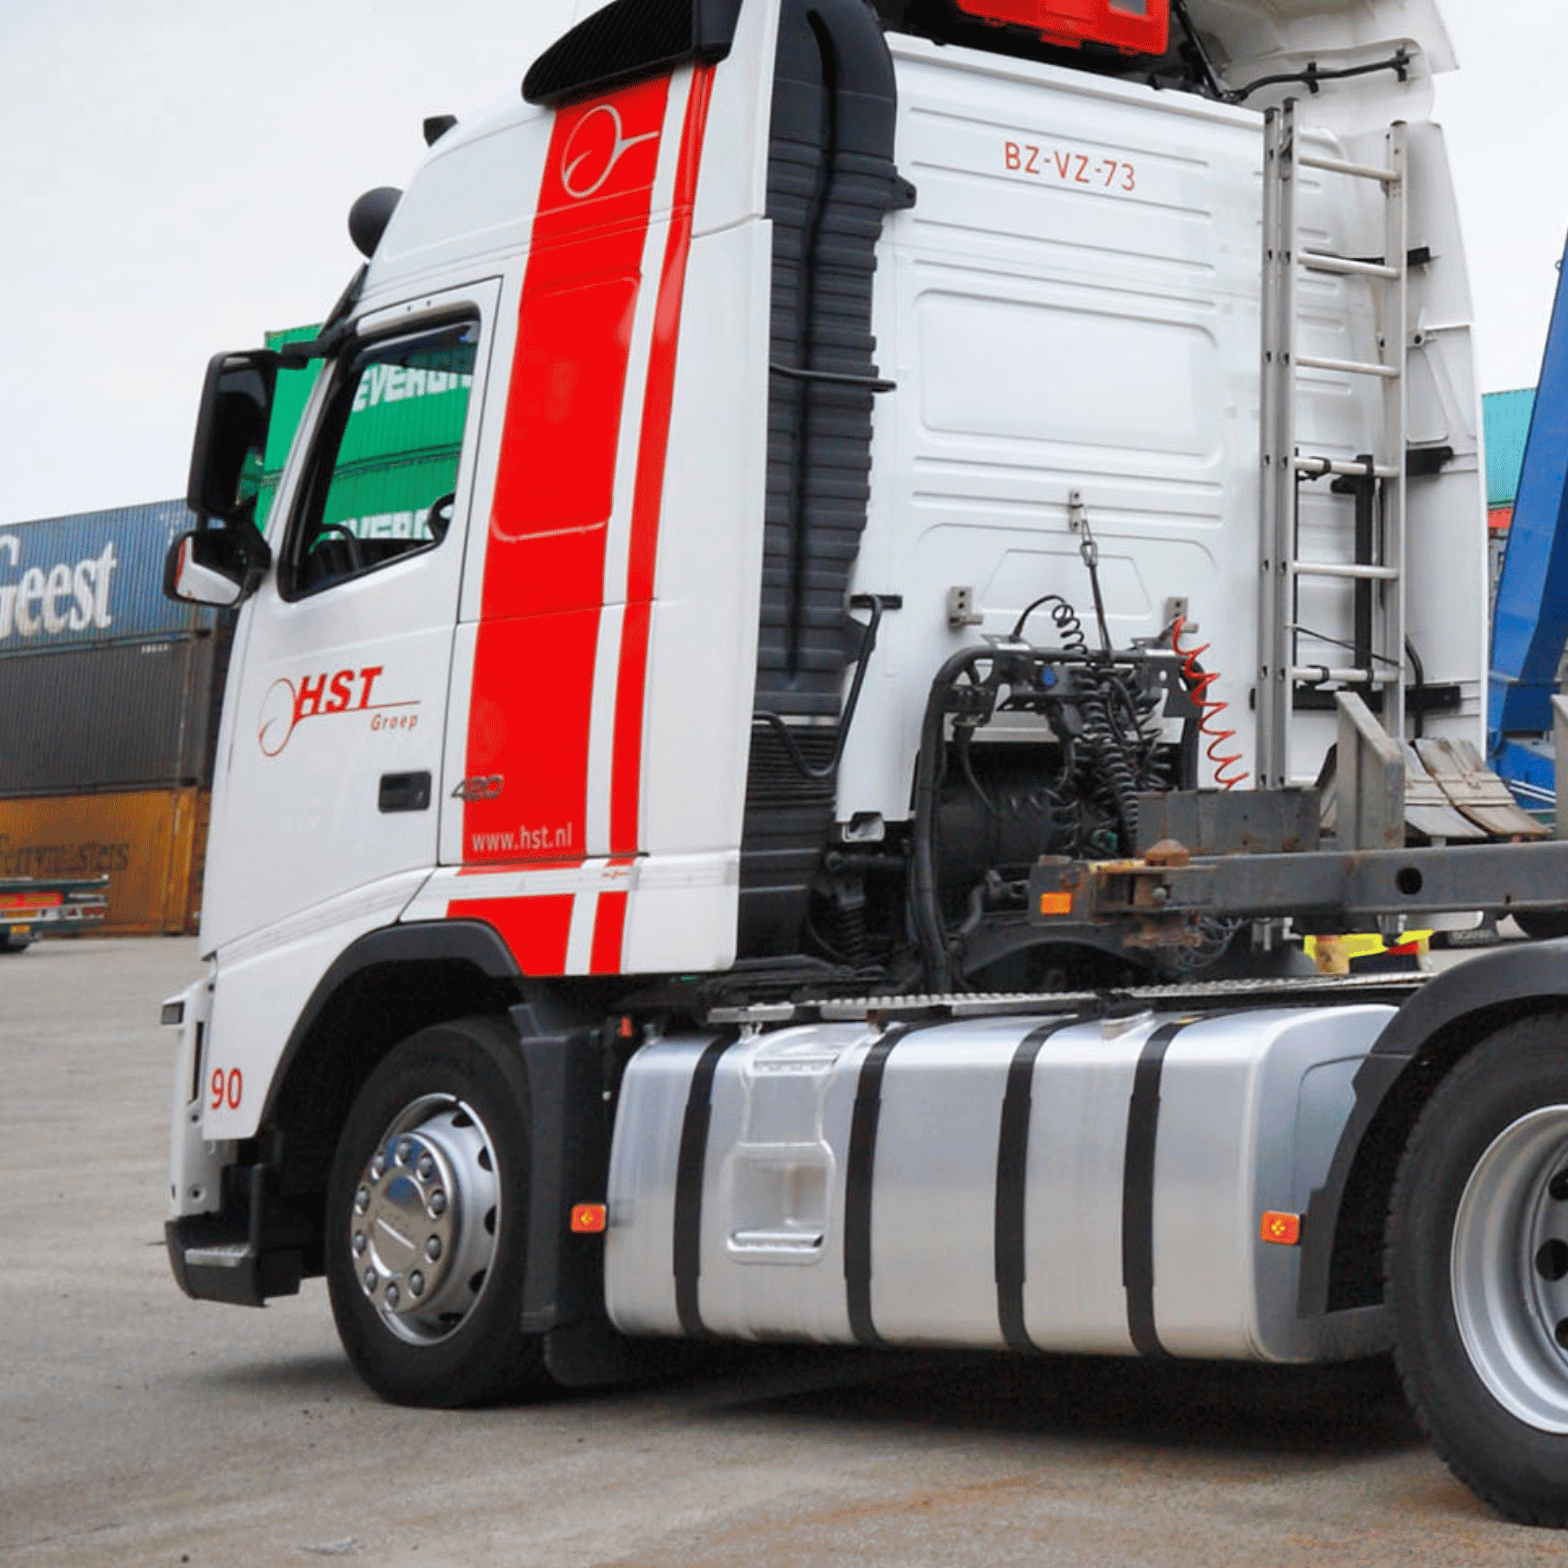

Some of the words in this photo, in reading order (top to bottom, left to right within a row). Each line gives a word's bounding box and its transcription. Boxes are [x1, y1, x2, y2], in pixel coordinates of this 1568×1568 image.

[1005, 141, 1135, 192] BZ-VZ-73
[296, 665, 384, 719] HST
[371, 713, 419, 731] Groep
[472, 821, 573, 852] www.hst.nl
[211, 1069, 243, 1110] 90
